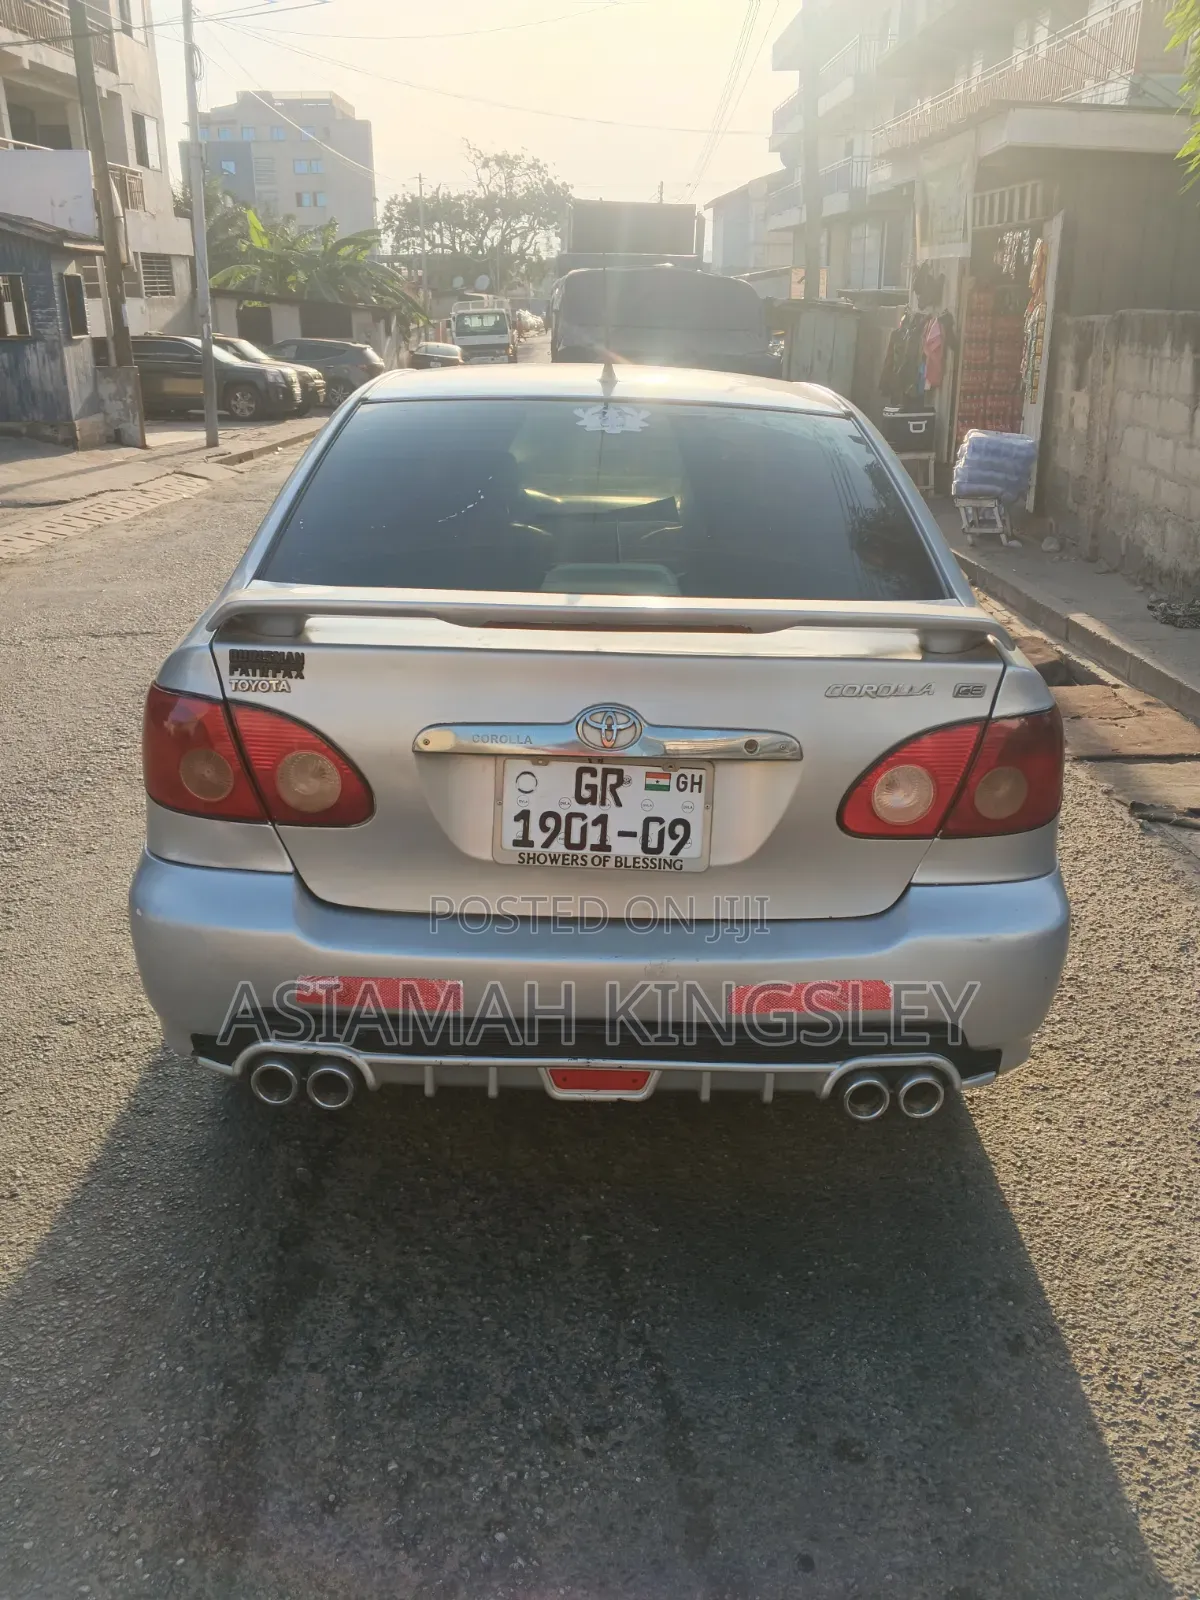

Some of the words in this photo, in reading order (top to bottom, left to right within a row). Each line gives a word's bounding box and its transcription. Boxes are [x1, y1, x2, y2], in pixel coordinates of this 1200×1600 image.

[230, 679, 291, 693] TOYOTA
[824, 682, 936, 699] COROLLA
[472, 734, 533, 745] COROLLA
[574, 766, 624, 807] GR
[676, 773, 703, 794] GH
[512, 809, 691, 856] 1901-09
[517, 852, 588, 867] SHOWERS
[592, 854, 610, 868] OF
[614, 857, 683, 871] BLESSING
